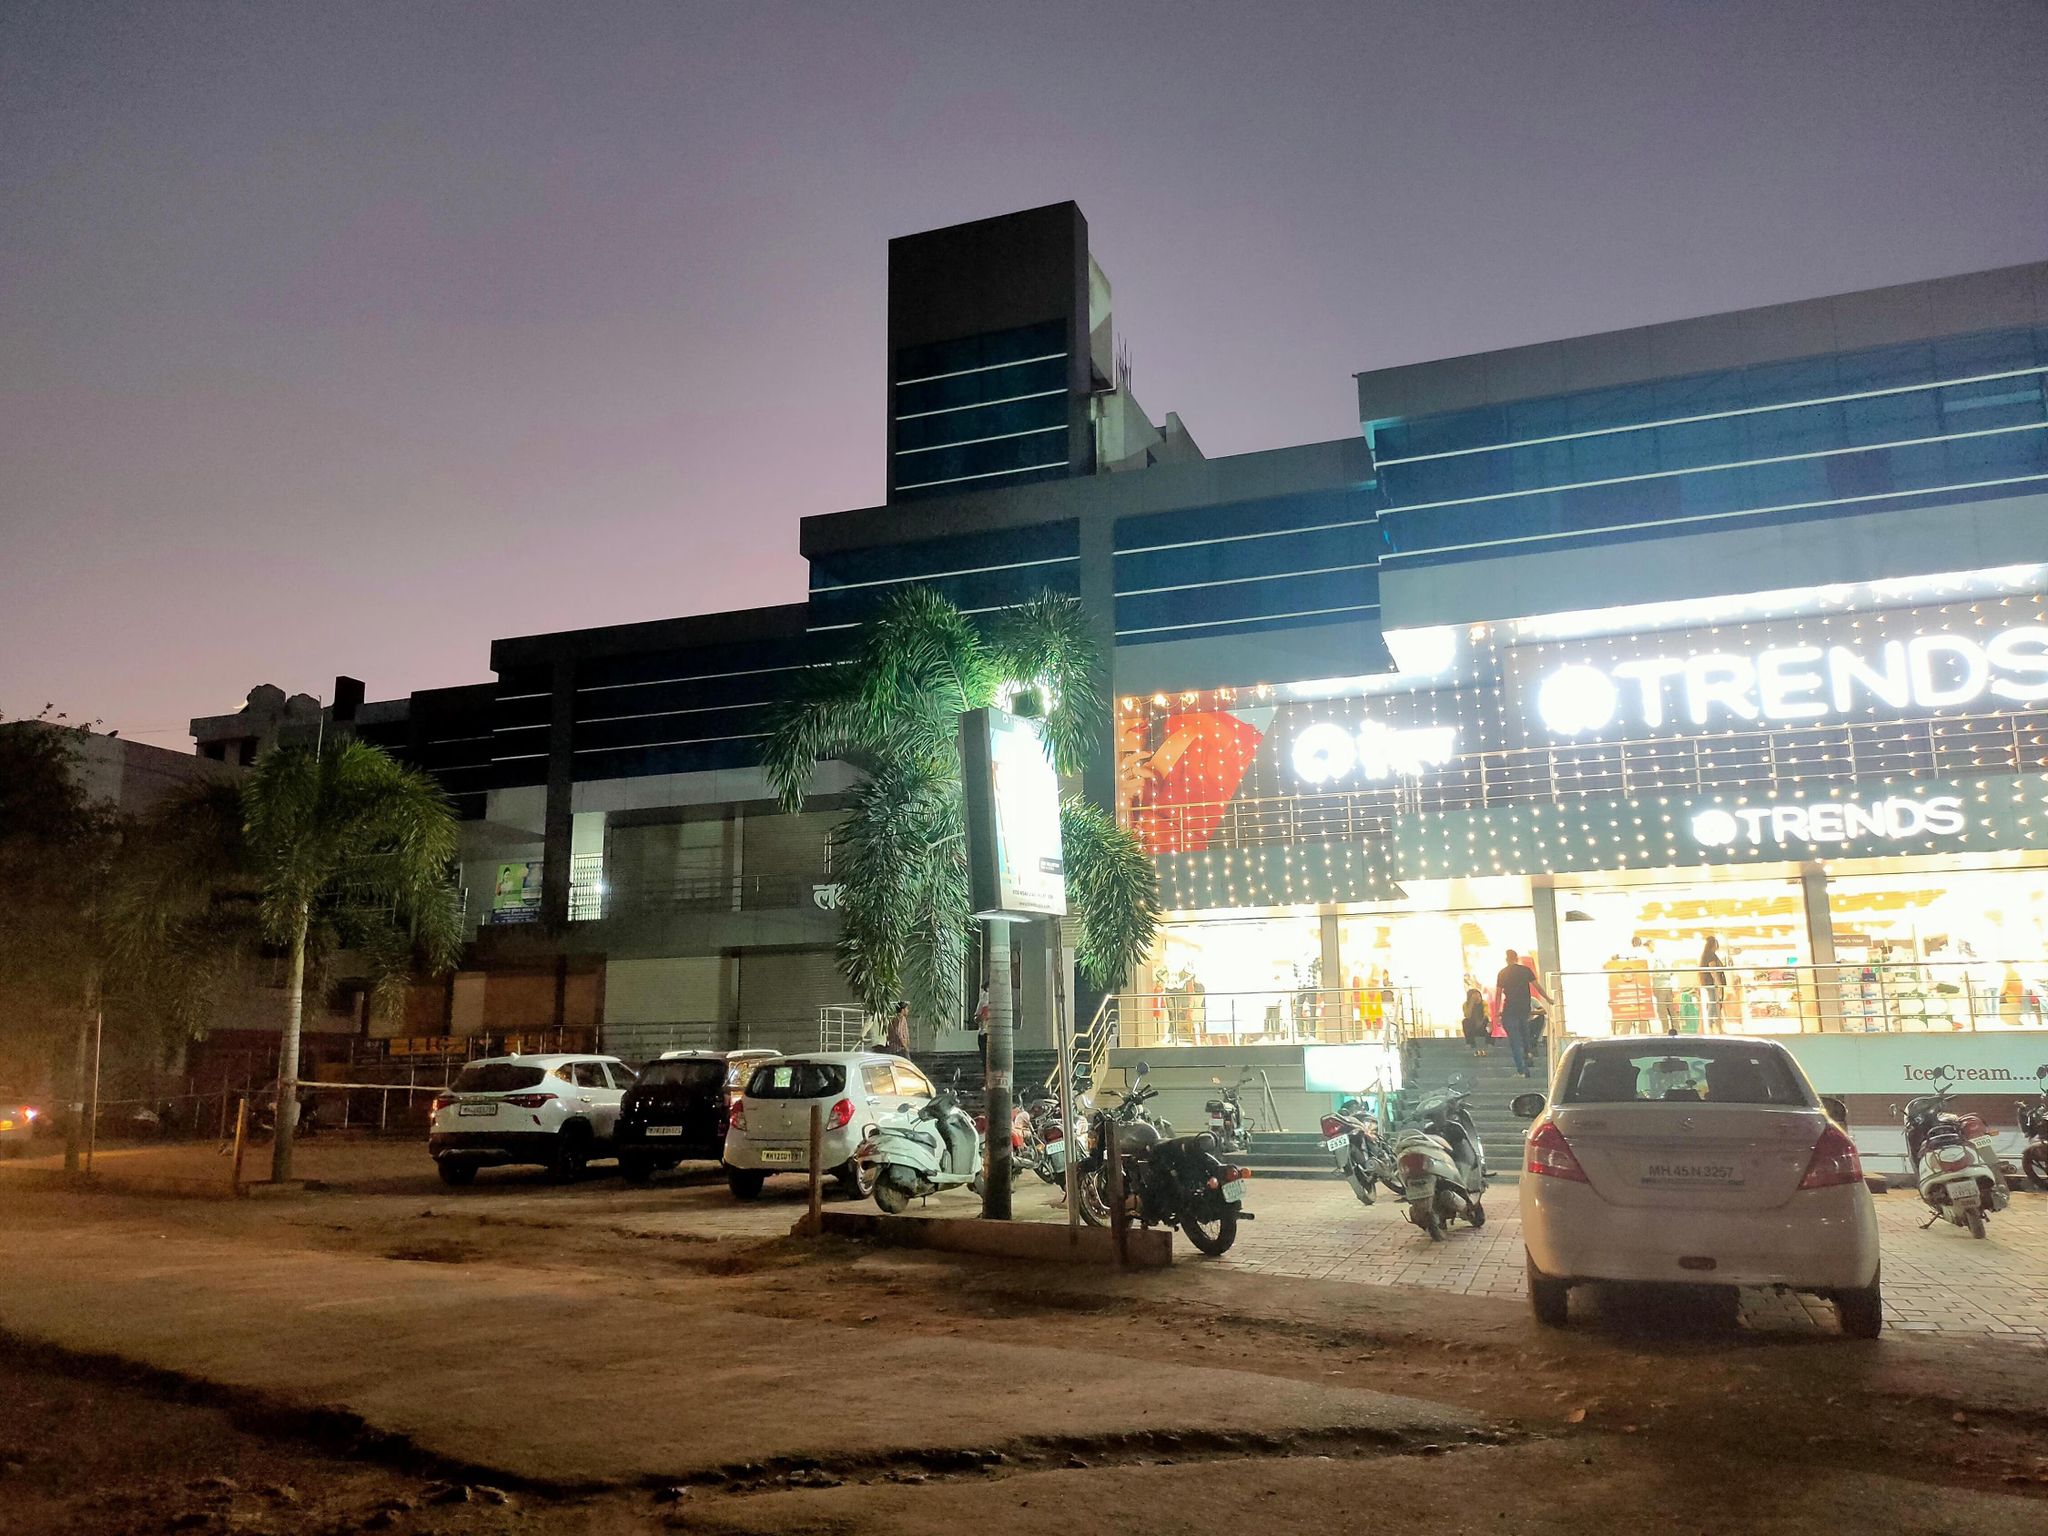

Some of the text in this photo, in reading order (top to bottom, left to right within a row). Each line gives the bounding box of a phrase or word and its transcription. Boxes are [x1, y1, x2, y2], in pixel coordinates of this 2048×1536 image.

[1613, 626, 2048, 728] TRENDS
[1735, 797, 1965, 845] TRENDS
[1904, 1064, 1935, 1081] Ice
